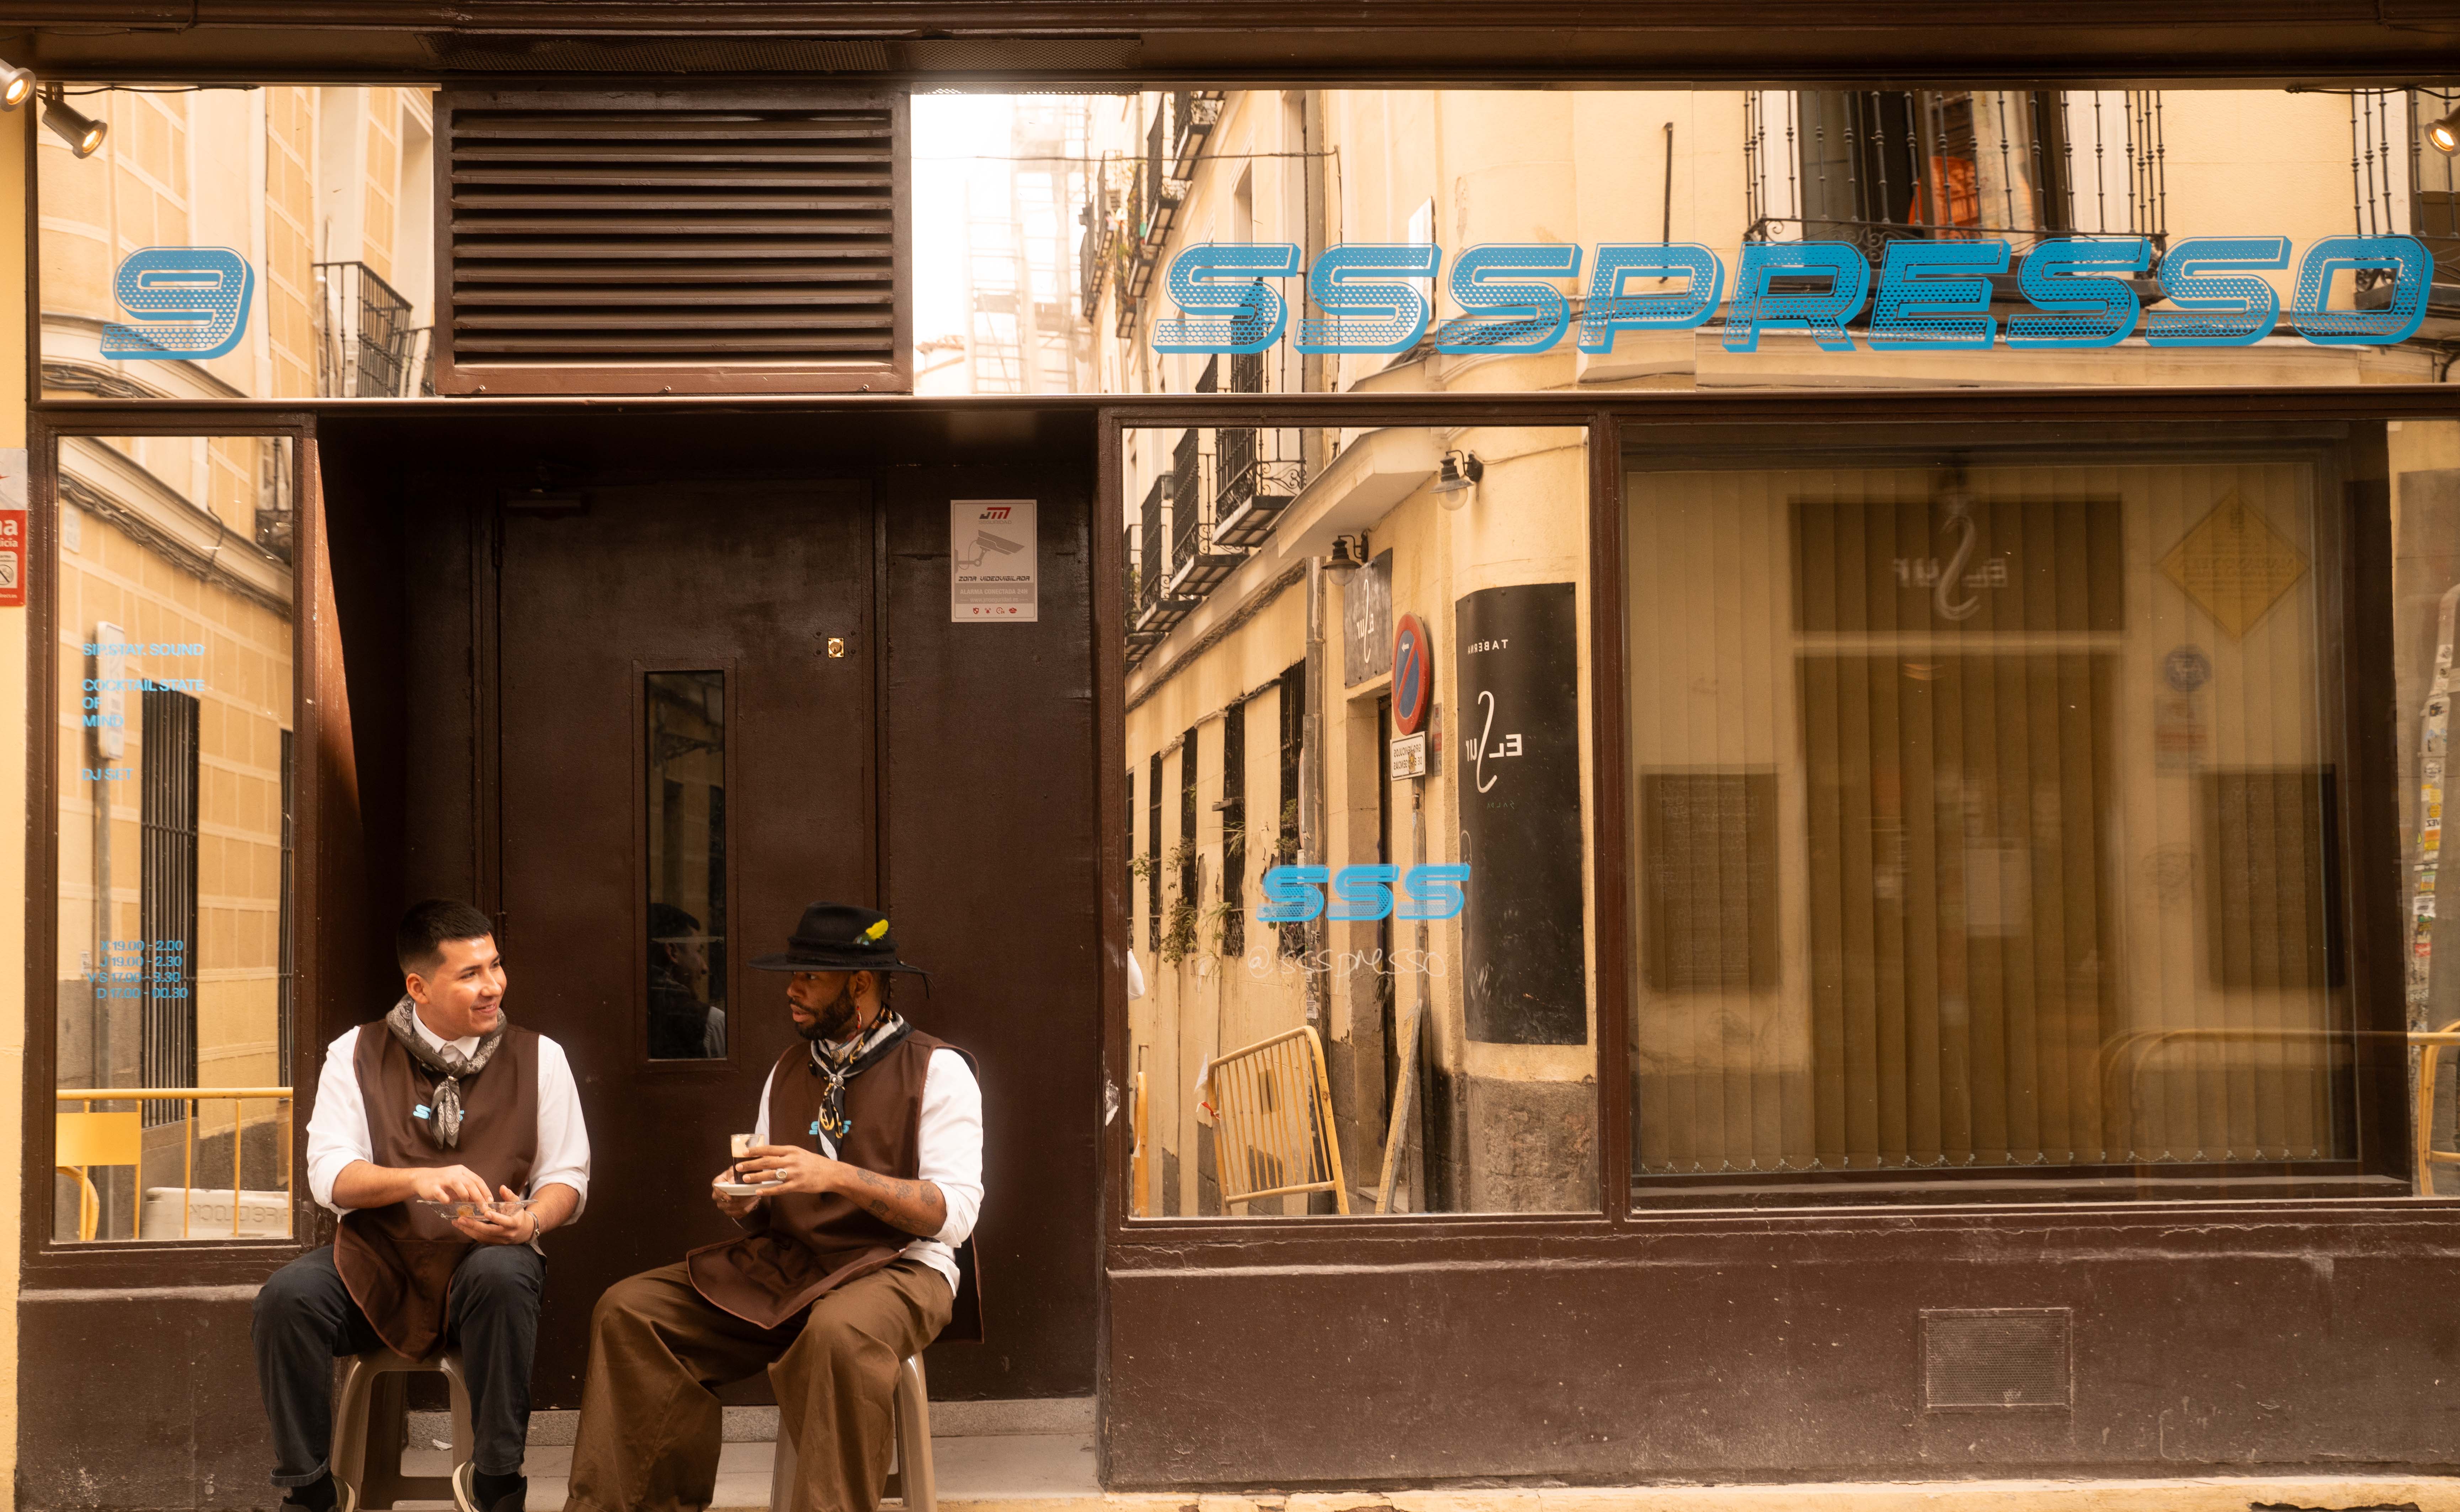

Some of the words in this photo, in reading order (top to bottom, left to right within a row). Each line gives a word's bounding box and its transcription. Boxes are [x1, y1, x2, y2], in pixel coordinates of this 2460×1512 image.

[1151, 234, 2435, 355] SSSPRESSO
[149, 643, 205, 656] SOUND
[82, 679, 158, 692] COCKTAIL
[159, 679, 205, 692] STATE
[82, 696, 102, 710] OF
[82, 714, 124, 727] MIND
[82, 768, 102, 781] DJ
[104, 768, 133, 781] SET
[1256, 862, 1471, 922] SSS
[100, 940, 109, 951] X
[112, 940, 145, 951] 19.00
[155, 940, 184, 951] 2.00
[100, 956, 108, 967] J
[111, 956, 144, 967] 19.00
[155, 956, 183, 967] 2.30
[87, 972, 96, 983] V
[98, 972, 108, 983] S
[110, 972, 142, 983] 17.00
[153, 972, 181, 983] 3.30
[96, 988, 107, 999] D
[110, 988, 142, 999] 17.00
[151, 987, 189, 999] 00.30
